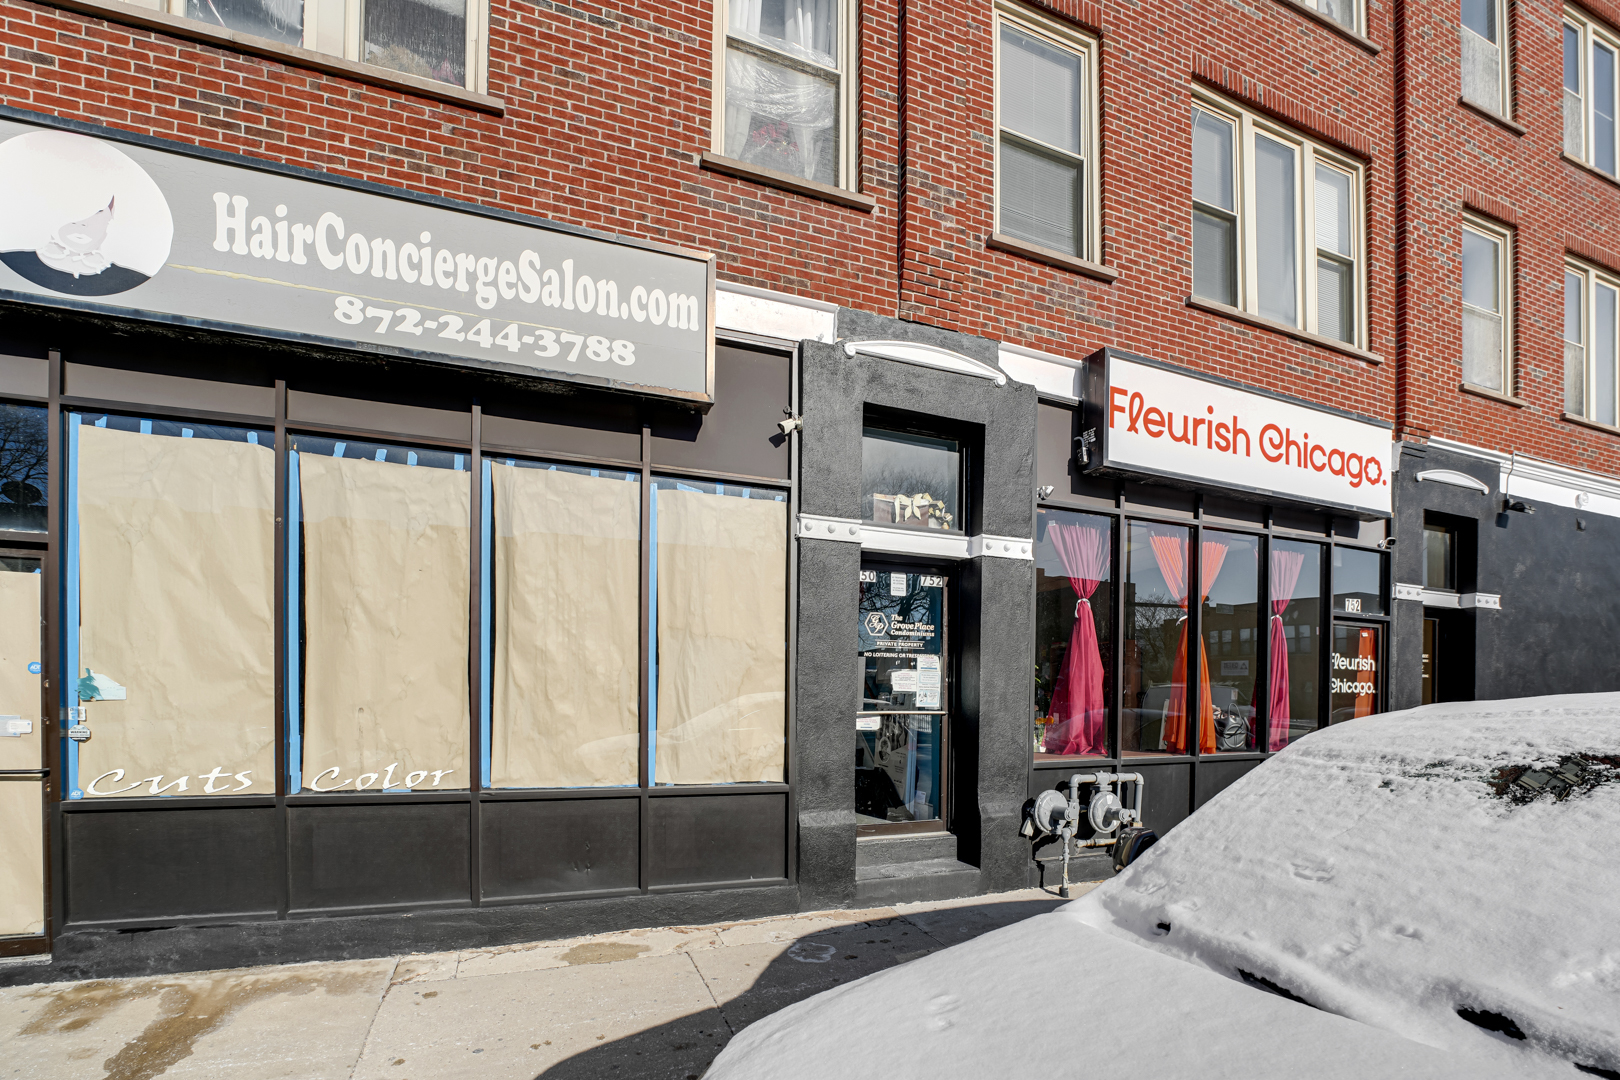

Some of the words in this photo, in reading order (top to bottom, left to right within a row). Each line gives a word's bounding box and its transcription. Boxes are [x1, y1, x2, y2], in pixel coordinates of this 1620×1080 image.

[213, 192, 700, 332] HairConciergeSalon.com
[333, 295, 636, 366] 872-244-3788
[1109, 386, 1251, 457] Fleurish
[1258, 423, 1388, 488] Chicago.
[921, 575, 942, 586] 752
[1346, 599, 1360, 612] 752
[891, 622, 915, 630] Grove
[914, 622, 935, 631] Place
[86, 766, 254, 796] Cuts
[310, 762, 454, 793] Color
